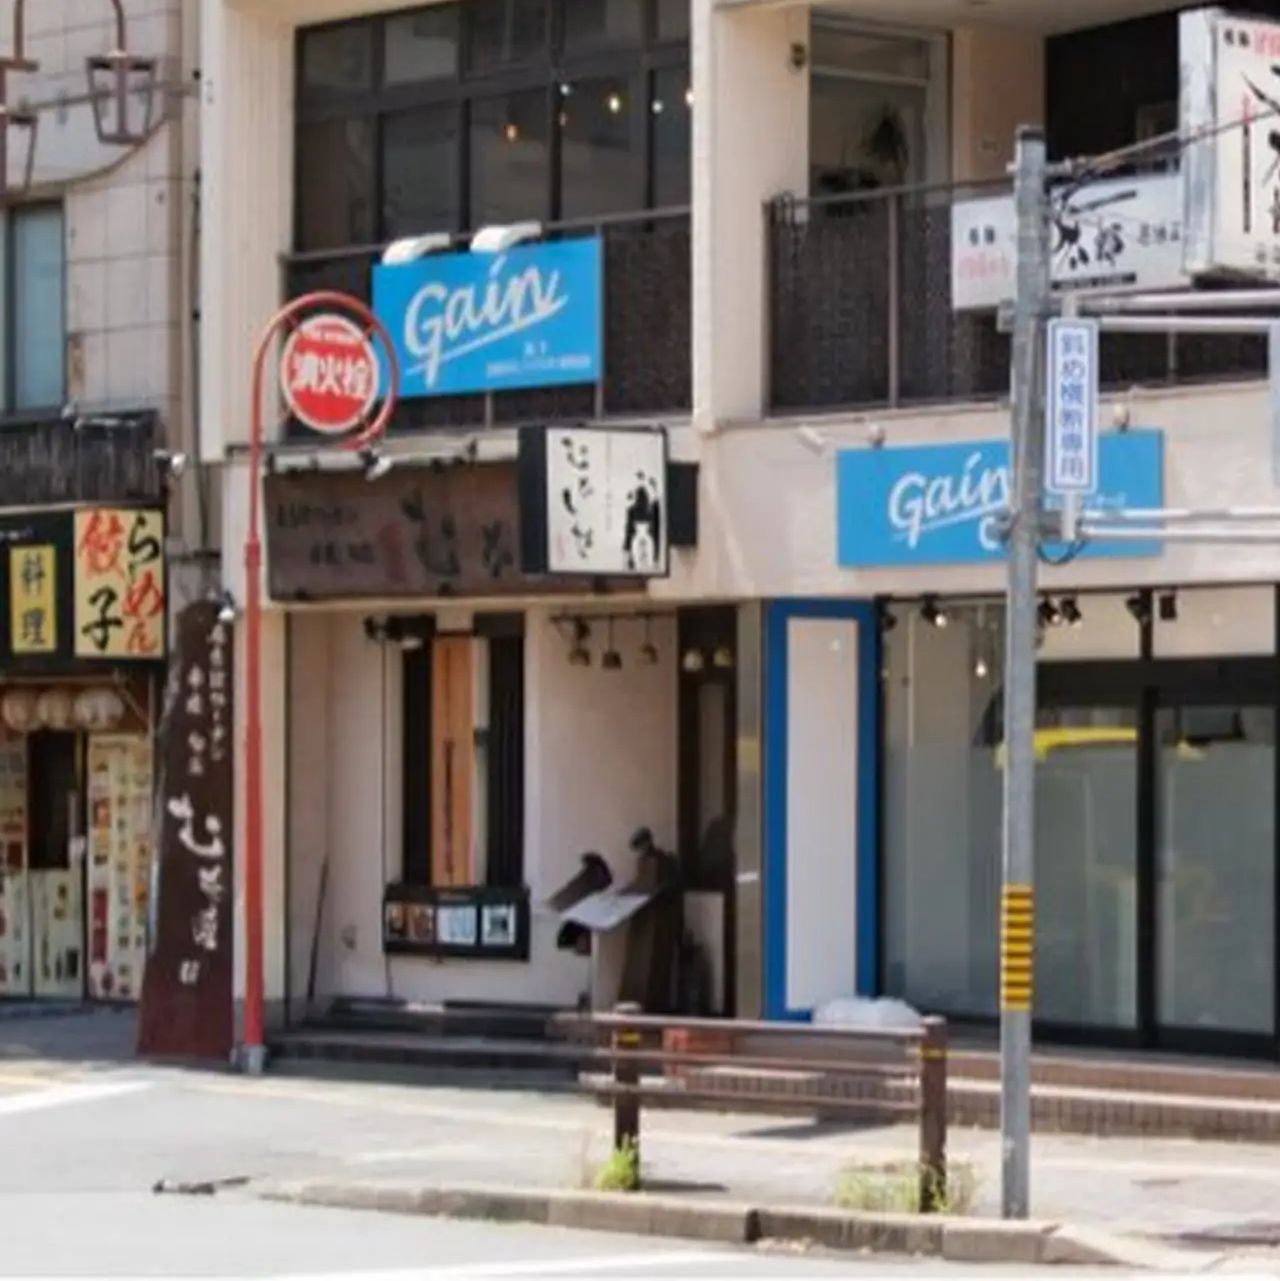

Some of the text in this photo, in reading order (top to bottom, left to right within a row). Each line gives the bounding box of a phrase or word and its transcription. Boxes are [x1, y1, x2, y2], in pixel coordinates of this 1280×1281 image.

[292, 353, 367, 399] 消火栓
[404, 256, 567, 388] Gain
[79, 512, 124, 650] 餃子
